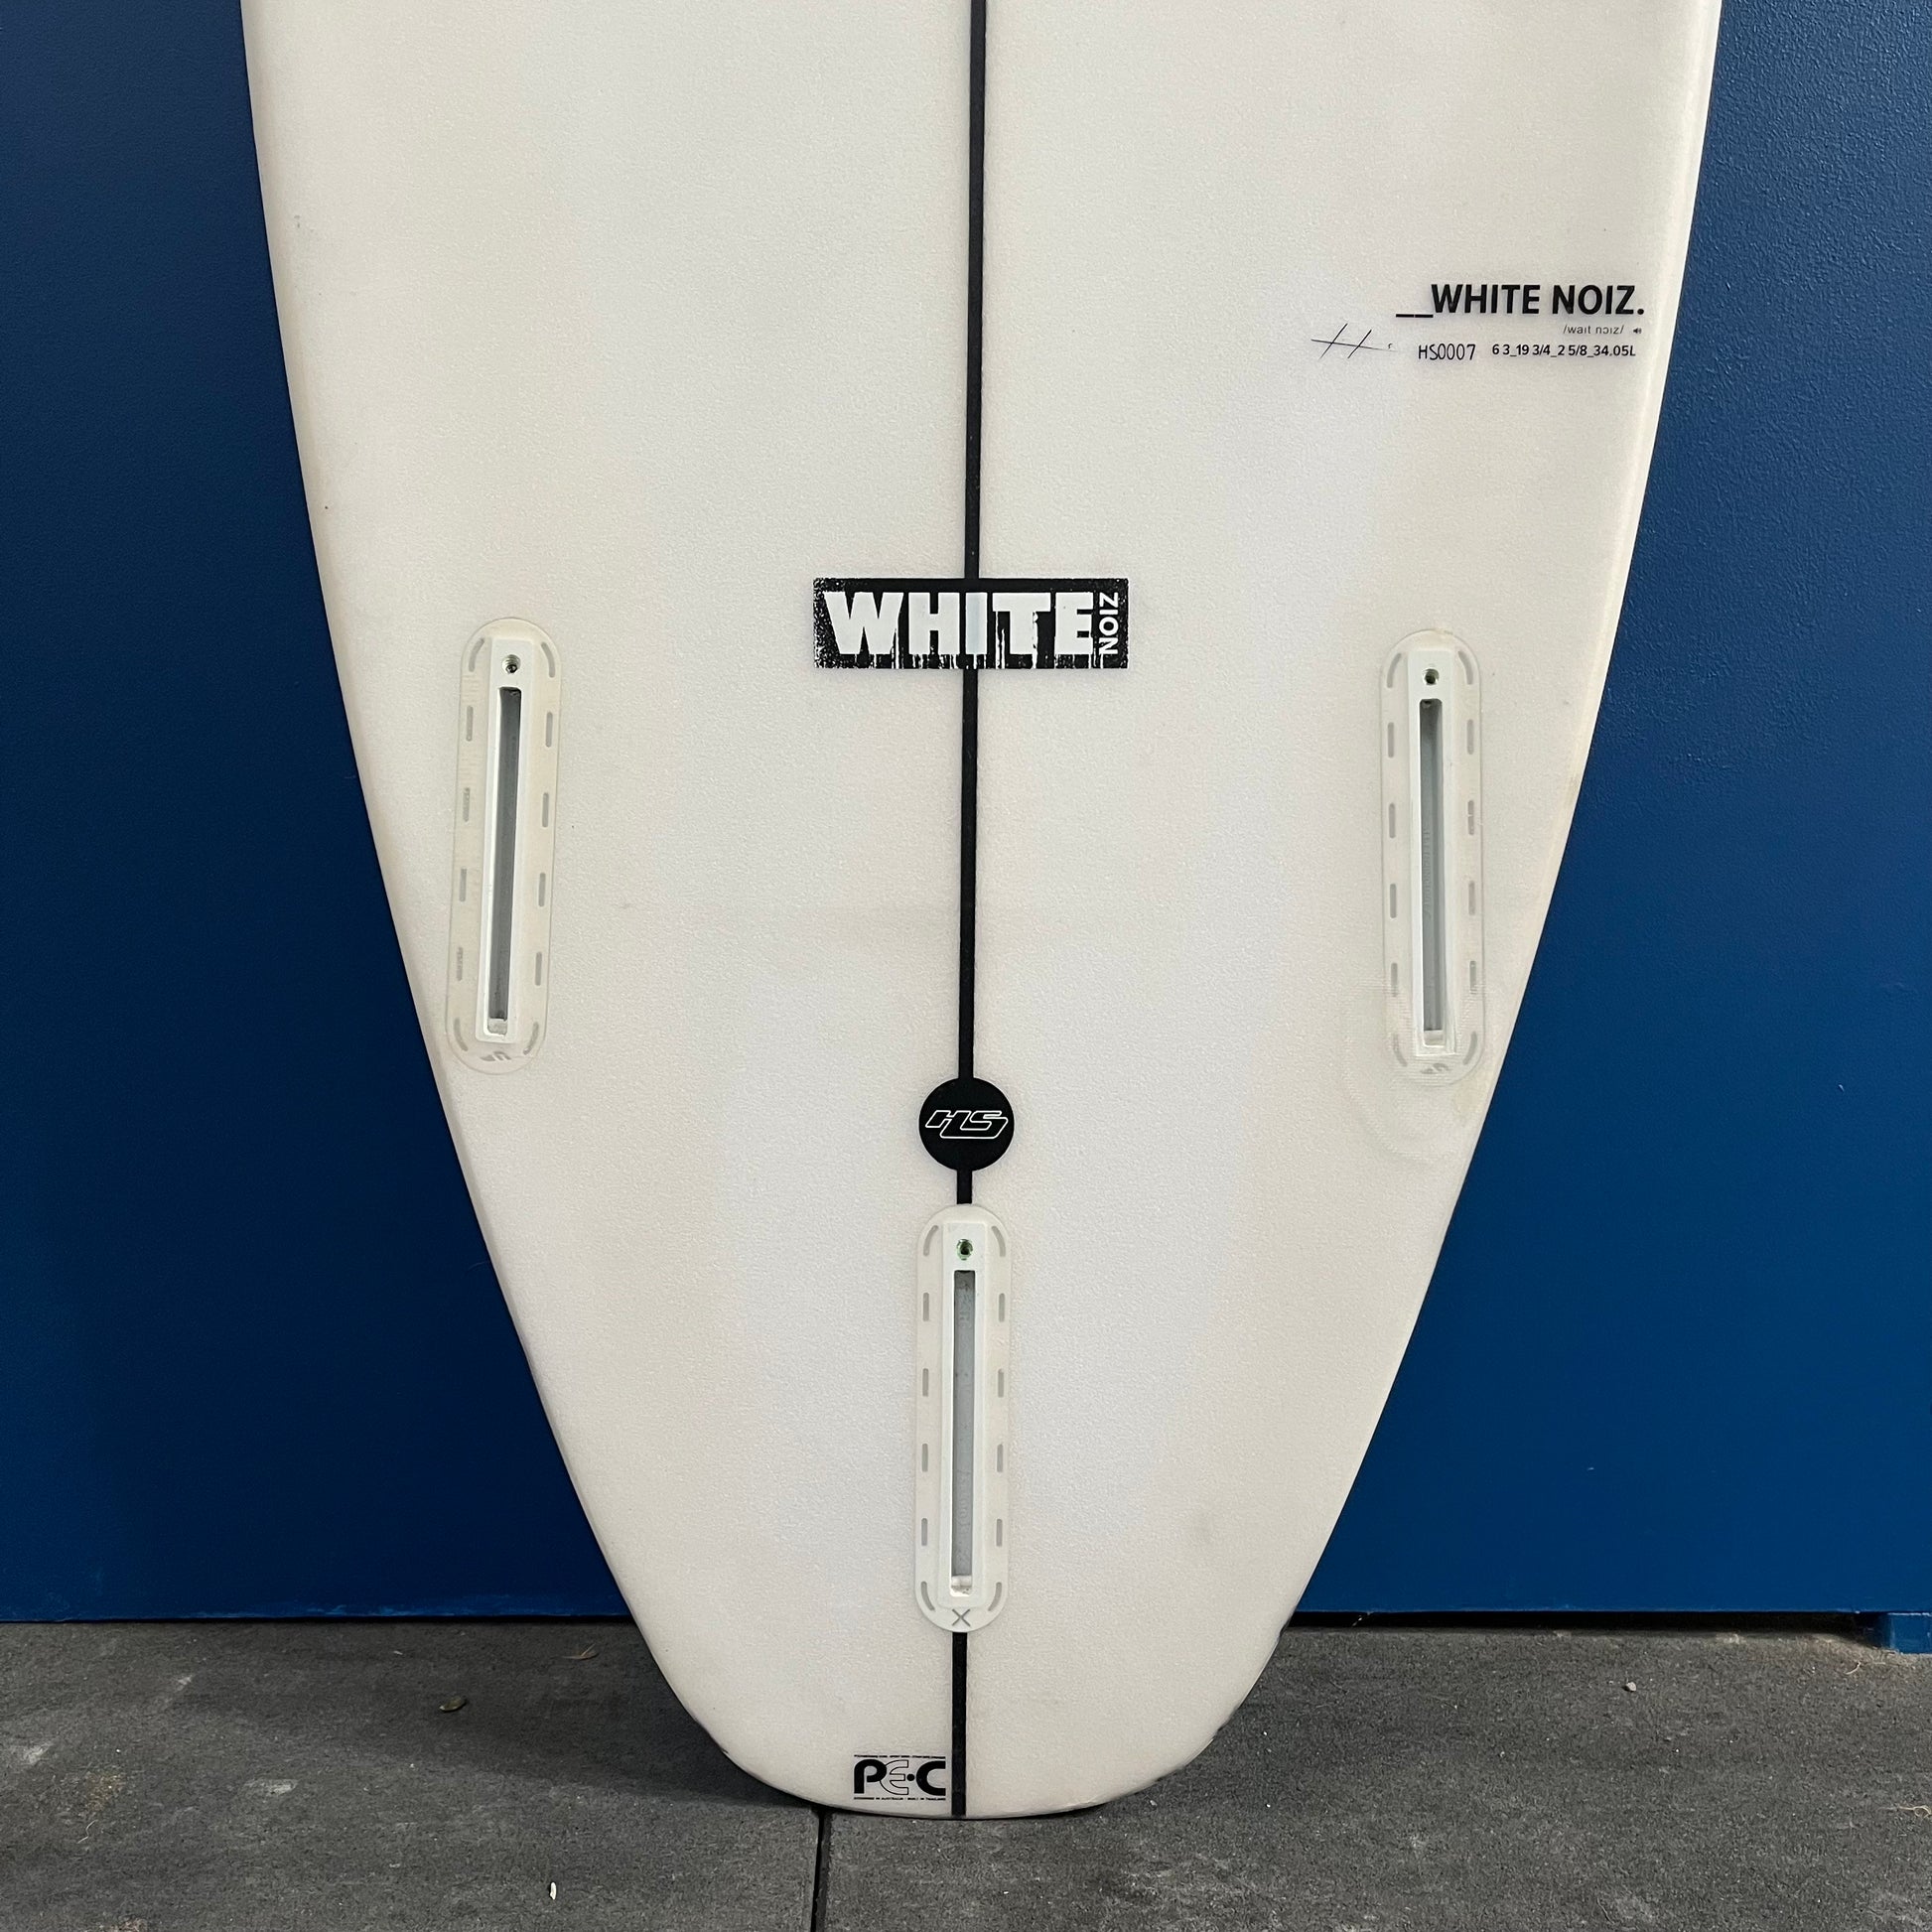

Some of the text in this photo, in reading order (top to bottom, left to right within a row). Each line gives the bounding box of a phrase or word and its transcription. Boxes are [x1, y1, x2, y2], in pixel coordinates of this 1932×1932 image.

[1552, 285, 1645, 315] NOIZ.
[1418, 344, 1476, 360] HS0007
[823, 591, 1095, 655] WHITE
[1098, 592, 1119, 655] NOIZ
